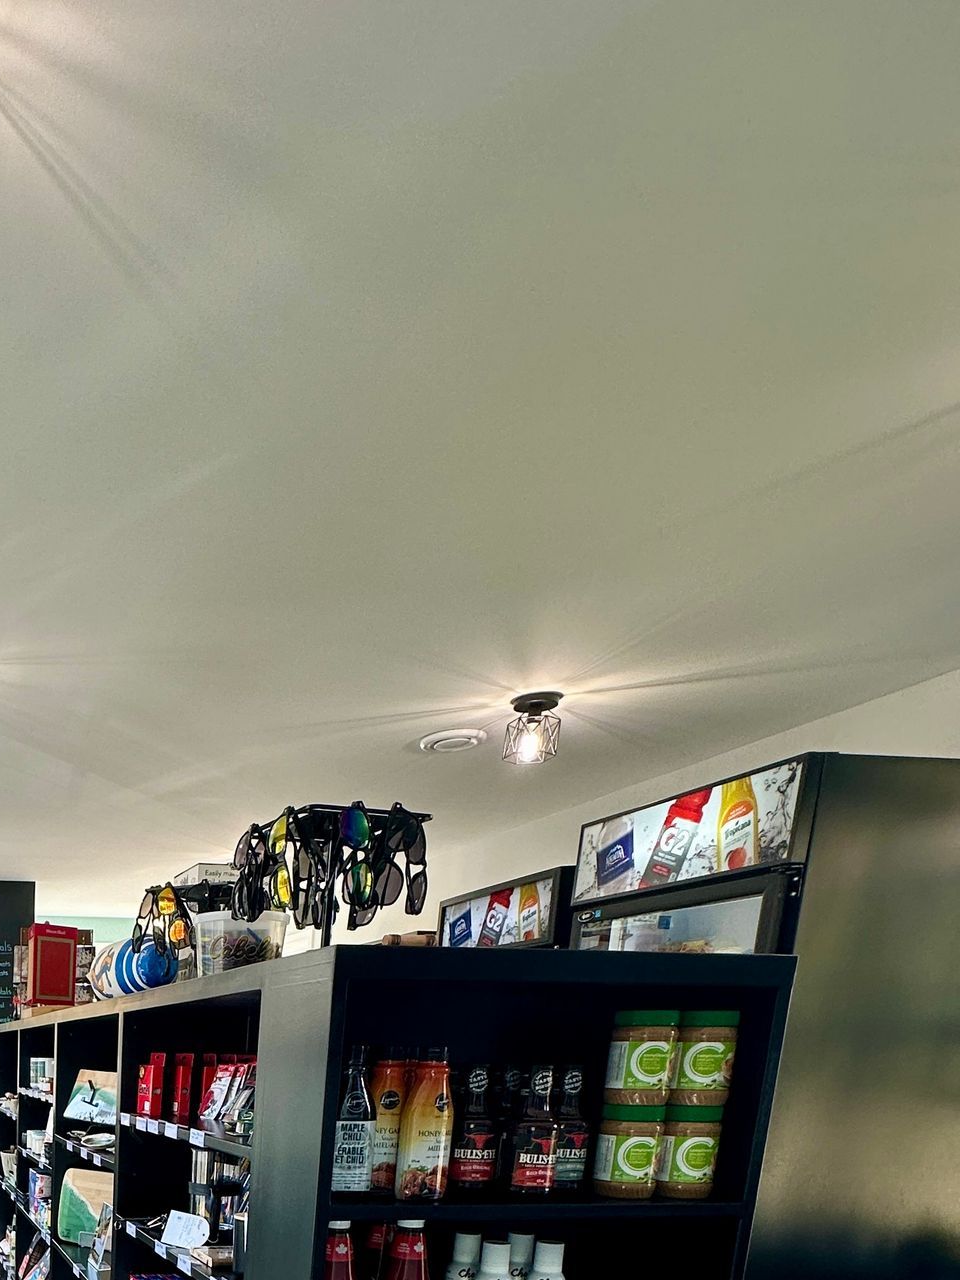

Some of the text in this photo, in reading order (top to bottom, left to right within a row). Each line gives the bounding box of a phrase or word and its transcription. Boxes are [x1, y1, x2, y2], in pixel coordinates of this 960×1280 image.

[660, 827, 690, 856] G2
[205, 869, 223, 878] Easily
[486, 909, 503, 932] G2
[341, 1123, 365, 1132] MAPLE
[342, 1132, 362, 1140] CHILI
[337, 1144, 364, 1155] ÉRABLE
[335, 1156, 364, 1164] ET CHILI
